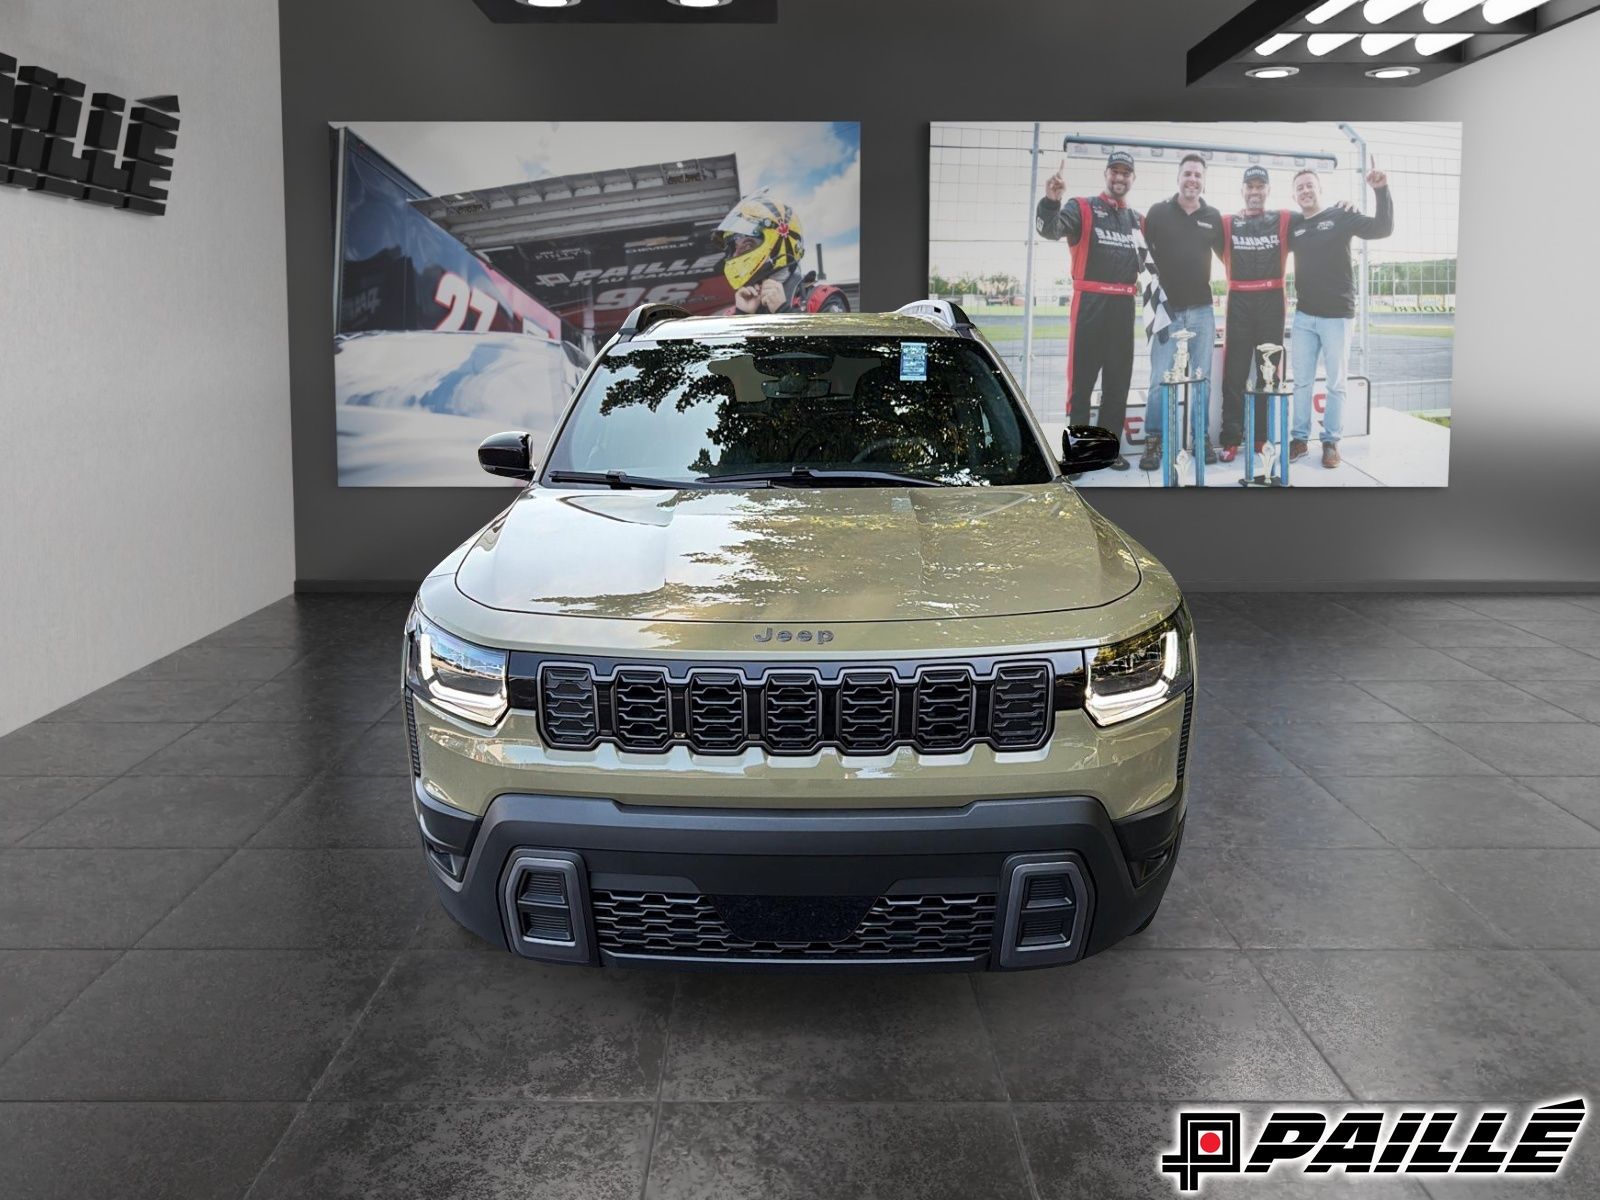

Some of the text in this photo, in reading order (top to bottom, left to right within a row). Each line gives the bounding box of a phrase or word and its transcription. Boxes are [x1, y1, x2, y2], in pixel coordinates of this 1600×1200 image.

[625, 241, 694, 254] CHEVROLET
[593, 282, 698, 310] 96
[753, 627, 835, 645] Jeep
